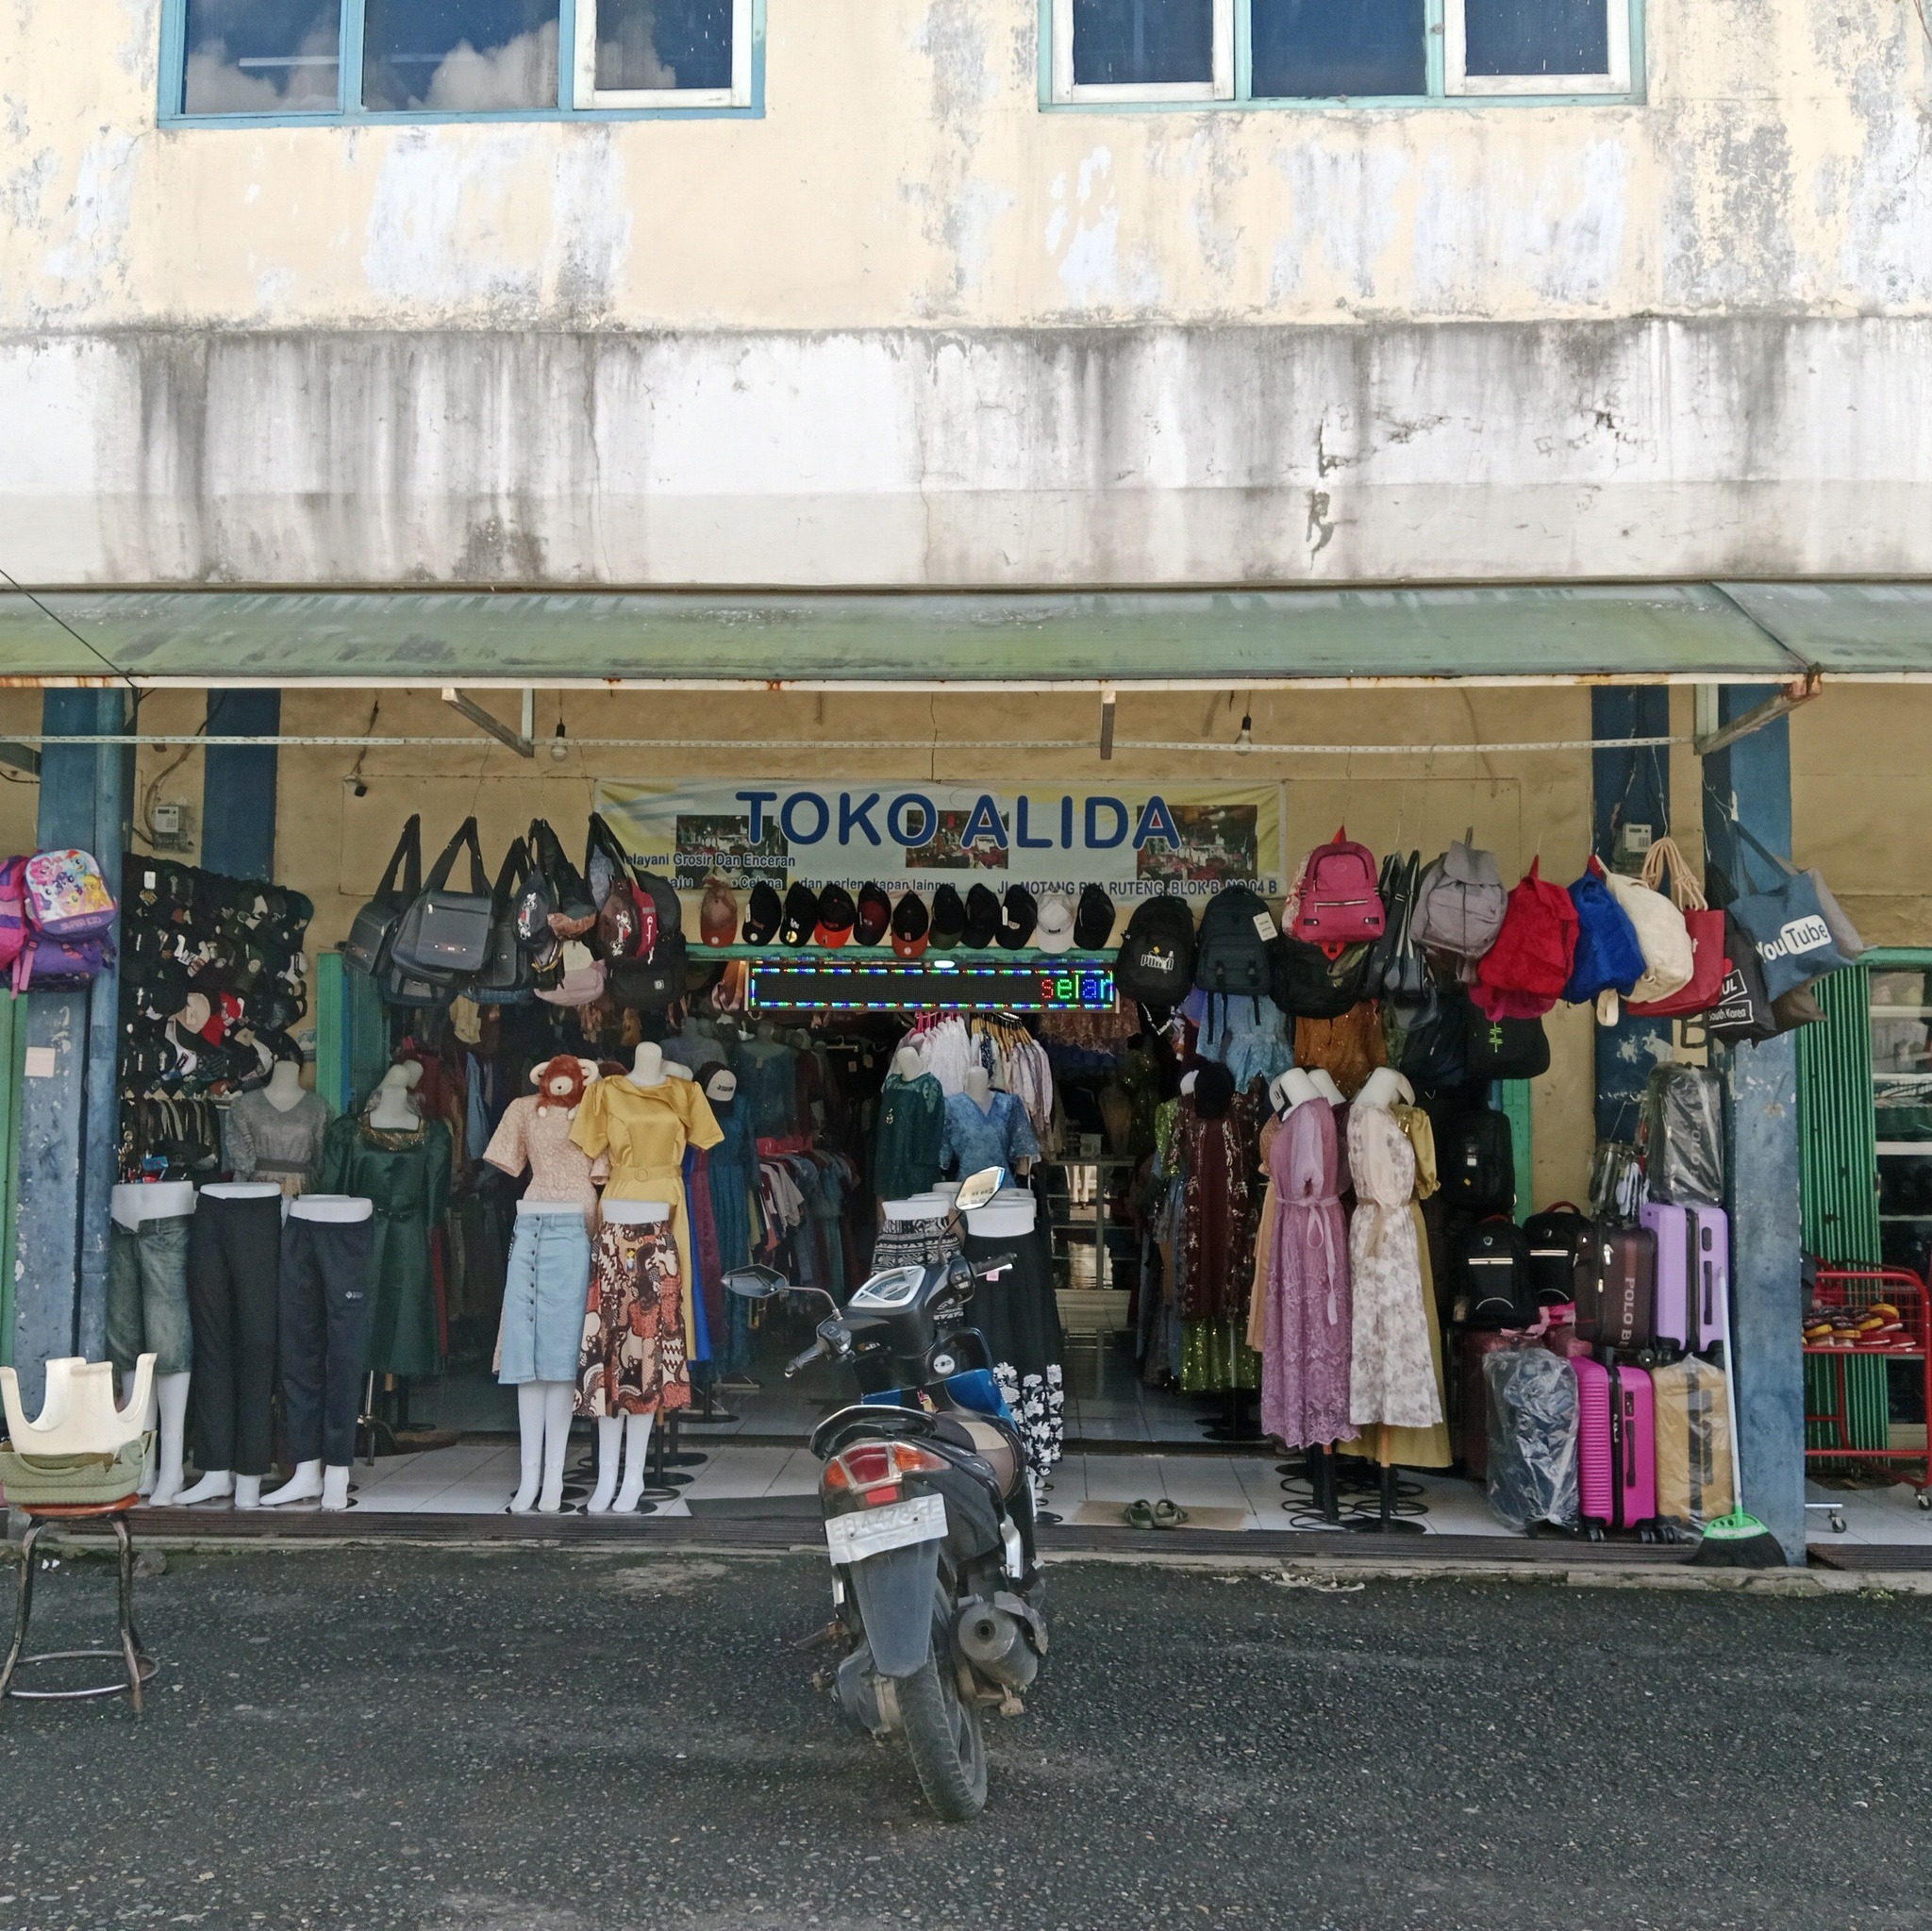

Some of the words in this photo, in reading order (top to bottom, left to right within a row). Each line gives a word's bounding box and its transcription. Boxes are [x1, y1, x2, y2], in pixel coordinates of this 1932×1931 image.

[735, 791, 937, 847] TOKO
[960, 794, 1181, 850] ALIDA
[625, 852, 670, 868] elayani
[674, 853, 712, 866] Grosir
[715, 853, 741, 866] Dan
[743, 853, 796, 867] Enceran
[670, 875, 694, 890] aju
[800, 876, 823, 890] dan
[1171, 880, 1207, 895] BLOK
[1269, 880, 1278, 893] B
[1624, 1277, 1636, 1324] POLO
